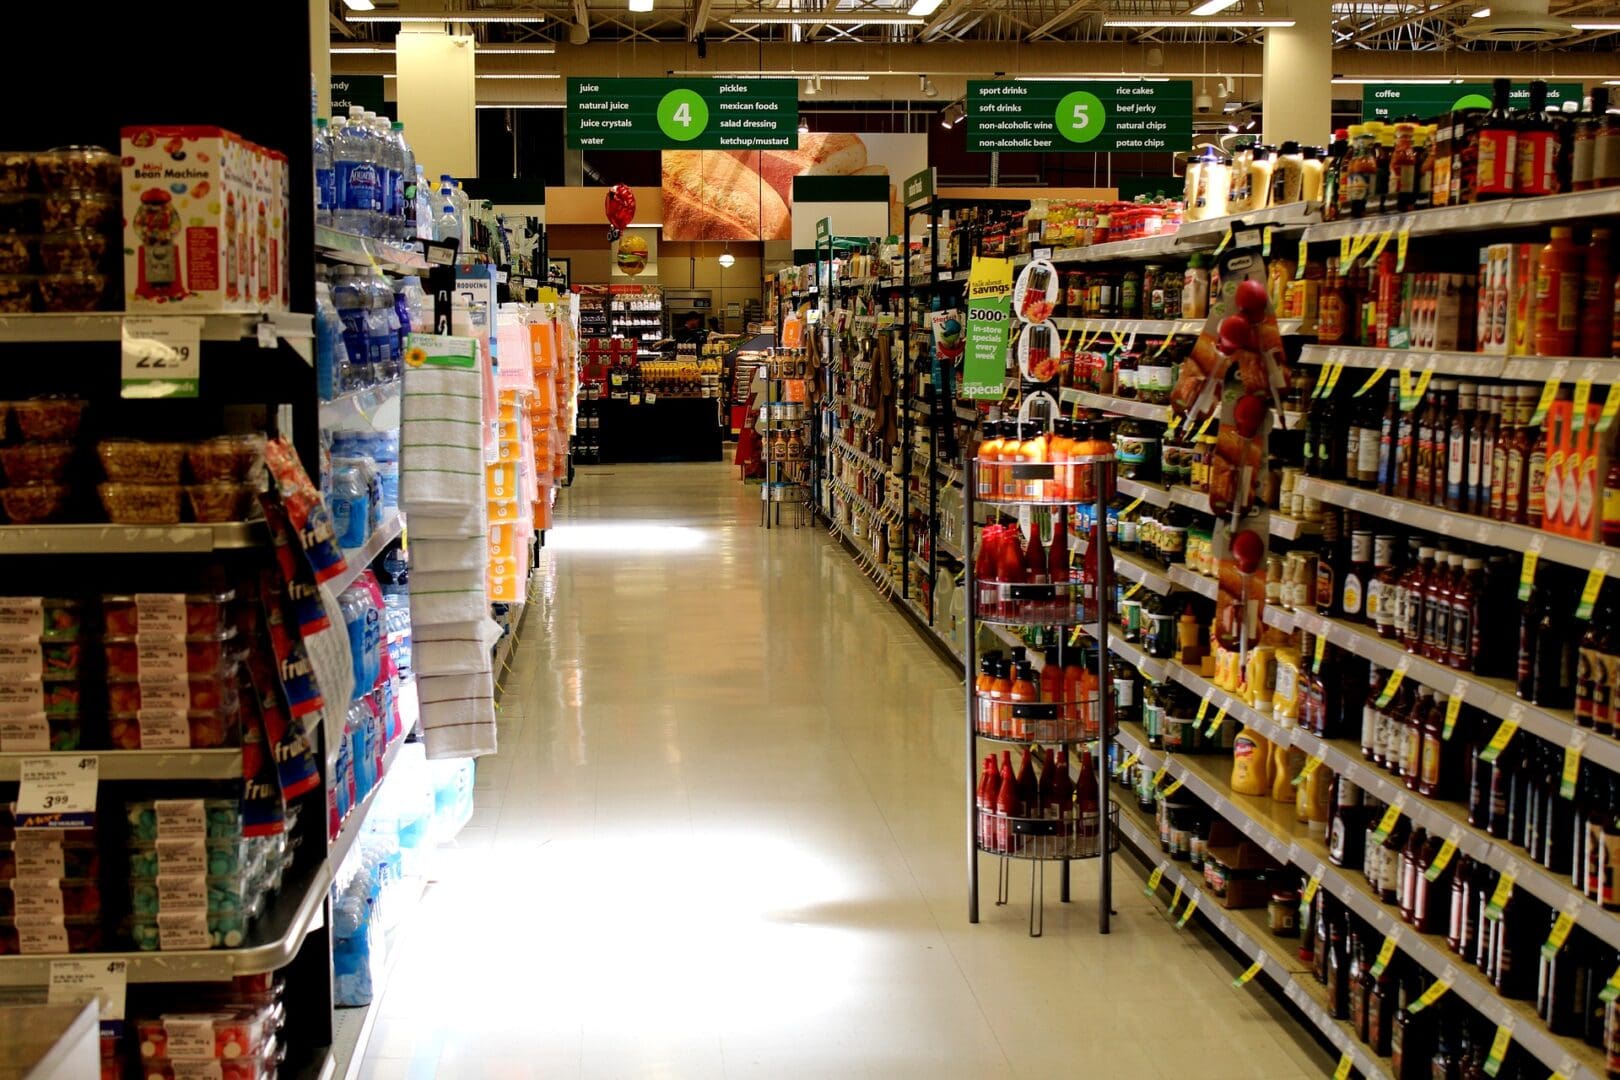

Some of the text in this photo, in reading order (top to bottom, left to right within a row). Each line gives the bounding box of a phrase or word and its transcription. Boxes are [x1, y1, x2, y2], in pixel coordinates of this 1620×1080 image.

[579, 83, 600, 94] juice
[719, 84, 748, 95] pickles
[979, 86, 1028, 97] sport drinks
[1116, 86, 1154, 95] rice cakes
[1374, 89, 1401, 98] coffee
[579, 101, 630, 111] natural juice
[719, 101, 779, 111] mexican foods
[979, 103, 1022, 112] soft drinks
[1116, 103, 1157, 114] beef jerky
[672, 102, 692, 127] 4
[1072, 104, 1089, 129] 5
[1375, 107, 1389, 117] tea
[580, 118, 633, 129] juice crystals
[719, 119, 777, 130] salad dressing
[979, 120, 1053, 130] non-alcoholic wine
[1116, 121, 1167, 131] natural chips
[580, 137, 605, 145] water
[720, 136, 789, 147] ketchup/mustard
[979, 138, 1052, 147] non-alcoholic beer
[1116, 138, 1165, 149] potato chips
[143, 162, 163, 170] Mini
[135, 168, 209, 179] Bean Machine
[972, 284, 1010, 294] savings
[972, 325, 1002, 334] in-store
[972, 334, 1002, 343] specials
[975, 344, 998, 354] every
[975, 352, 995, 360] week
[963, 383, 1004, 398] special
